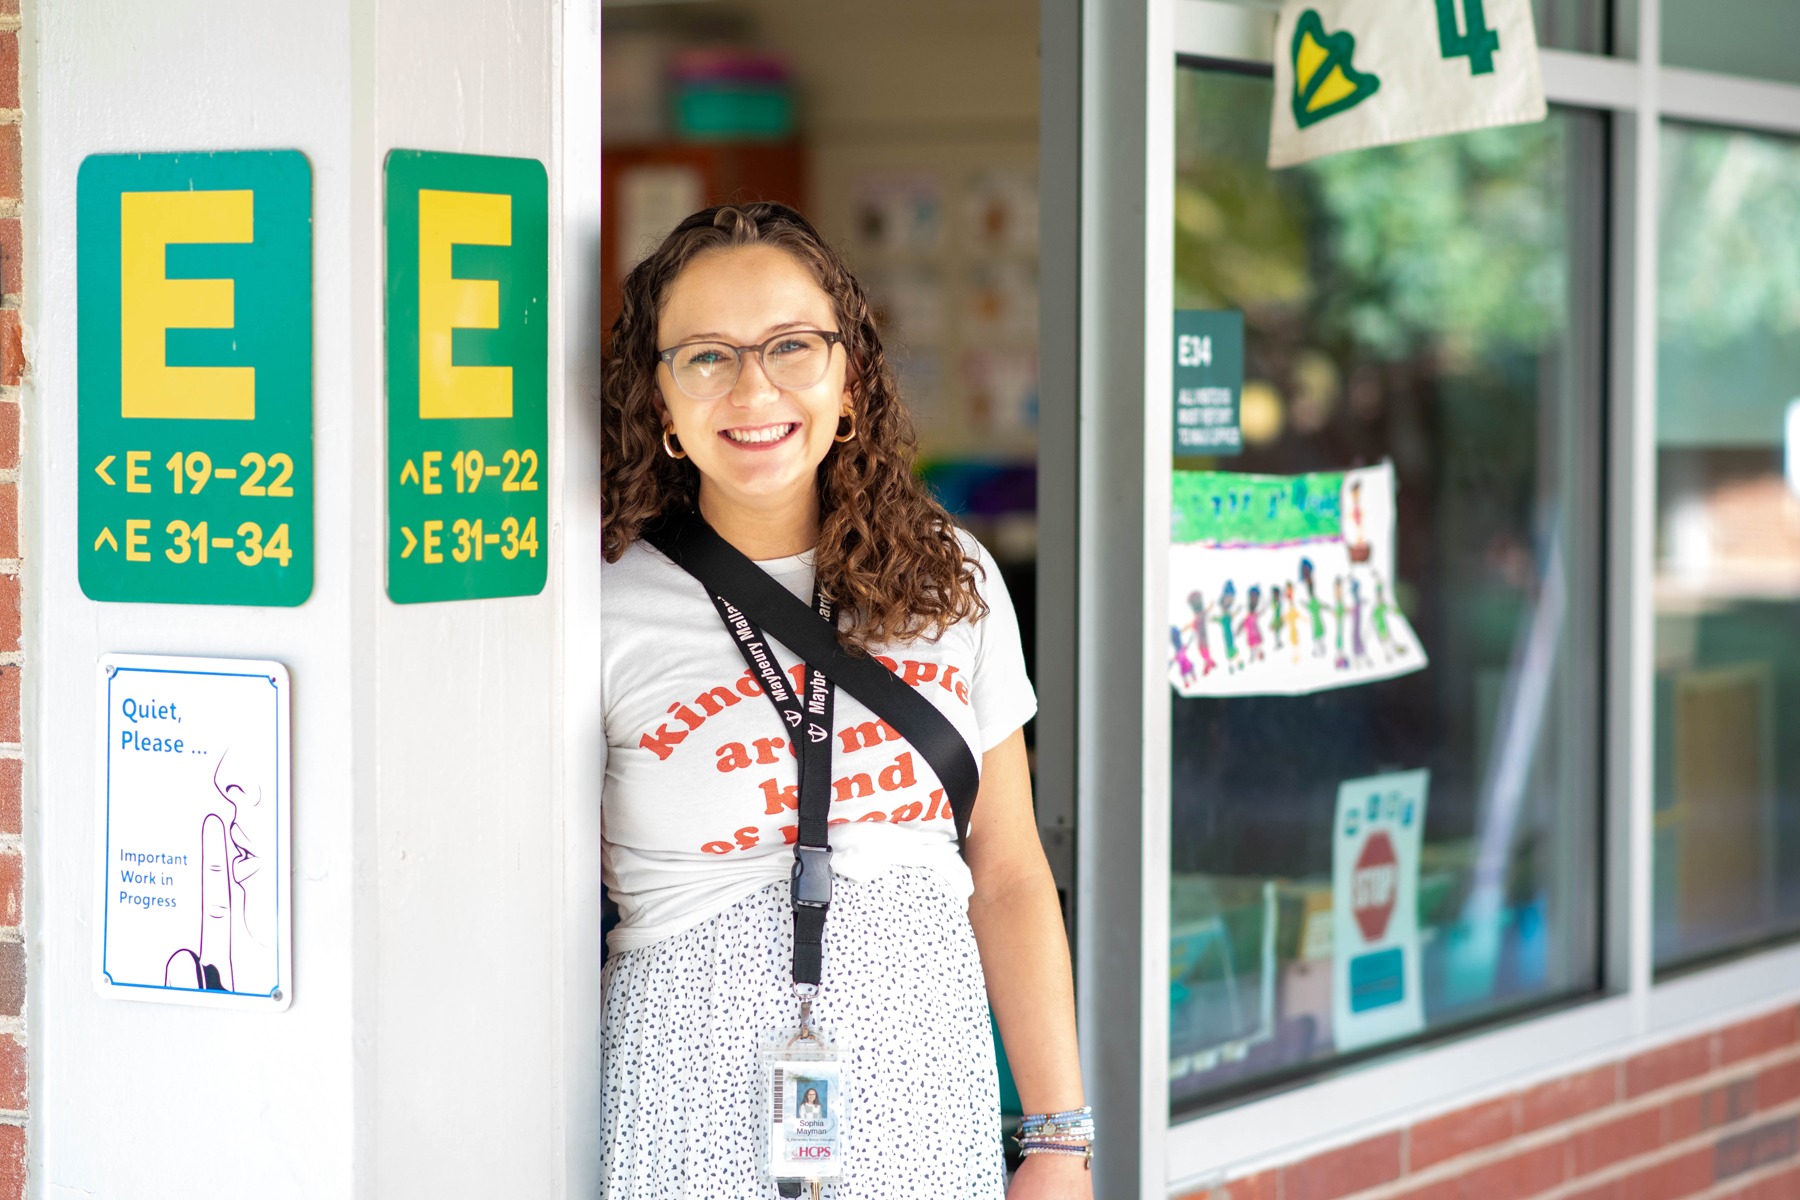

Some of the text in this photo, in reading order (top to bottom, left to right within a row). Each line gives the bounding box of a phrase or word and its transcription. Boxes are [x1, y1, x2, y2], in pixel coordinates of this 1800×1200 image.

[1435, 0, 1500, 76] 4
[121, 189, 255, 420] E
[418, 189, 514, 419] E
[1177, 334, 1213, 368] E34
[126, 451, 294, 498] E 19-22
[422, 448, 539, 495] E 19-22
[126, 519, 293, 567] E 31-34
[423, 516, 540, 564] E 31-34
[747, 642, 790, 702] Maybeury
[121, 697, 183, 724] Quiet,
[120, 730, 185, 754] Please
[716, 735, 801, 773] ar
[758, 752, 918, 815] knd
[119, 848, 189, 867] Important
[120, 870, 175, 887] Work in
[119, 890, 178, 910] Progress
[796, 1127, 827, 1136] Mayman
[799, 1119, 825, 1128] Sophia
[799, 1146, 831, 1158] HCPS
